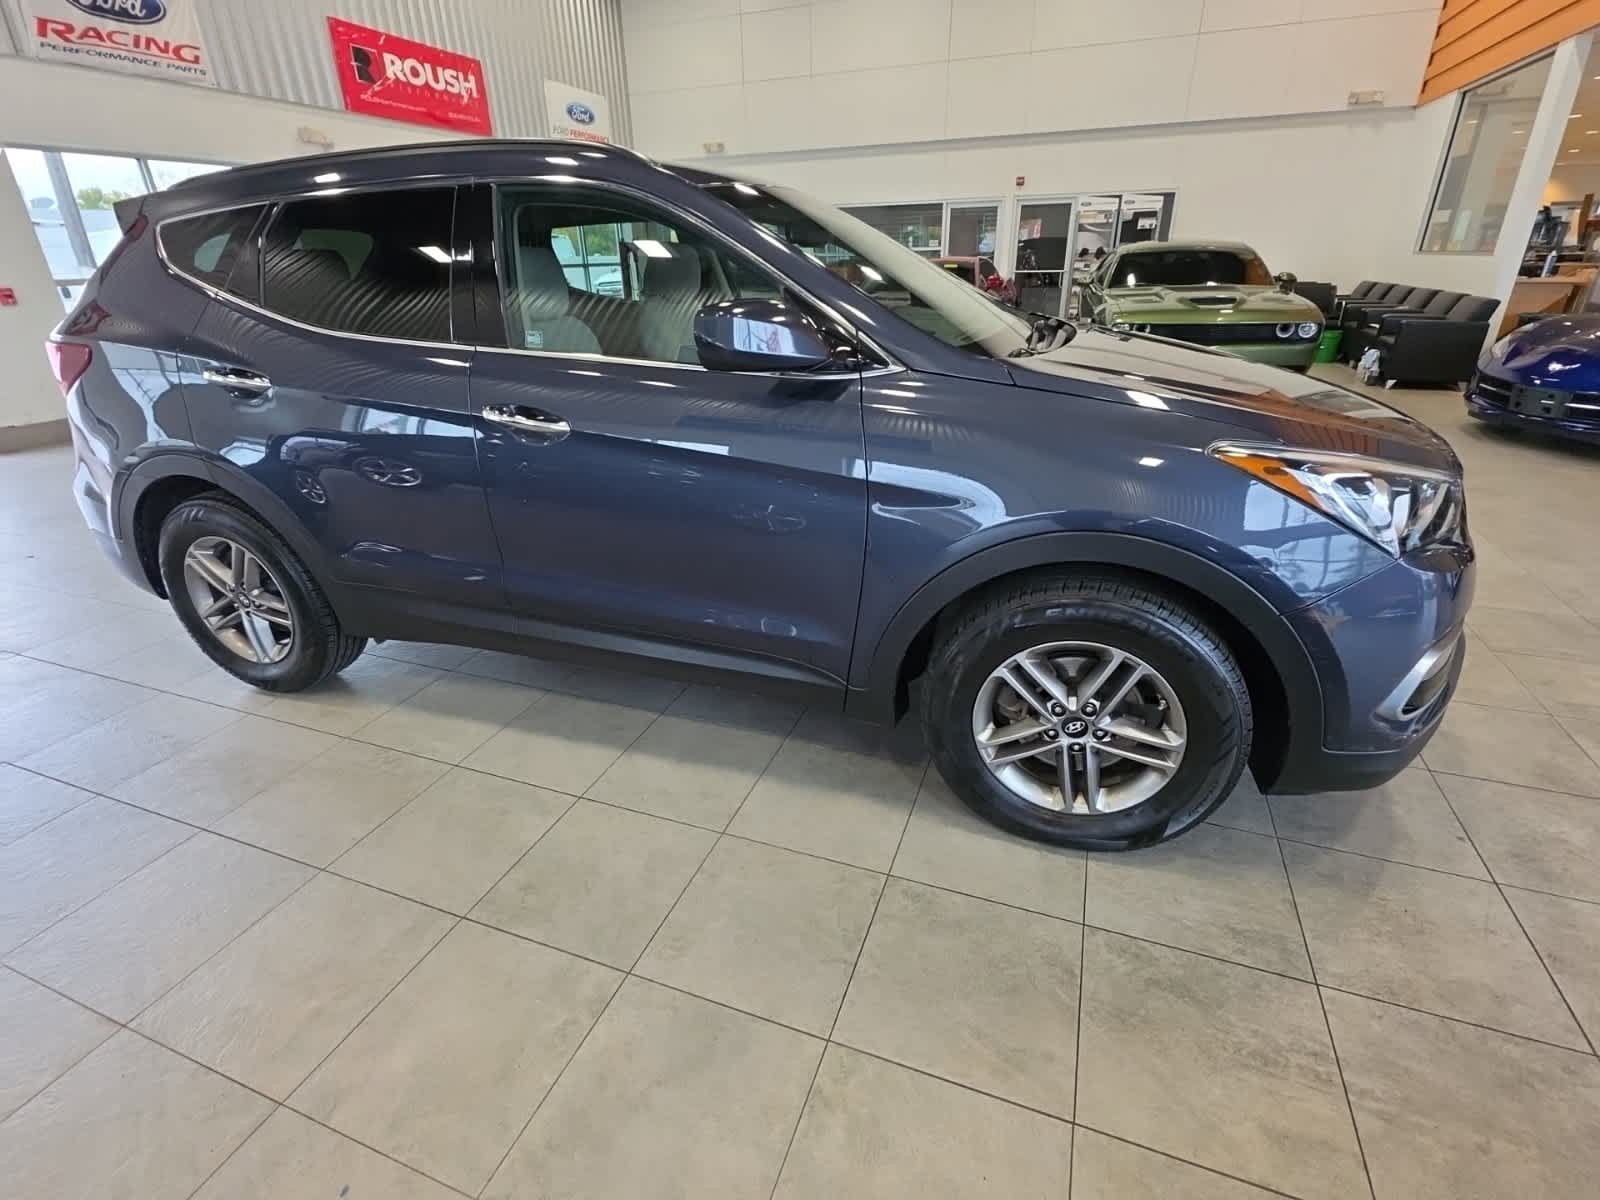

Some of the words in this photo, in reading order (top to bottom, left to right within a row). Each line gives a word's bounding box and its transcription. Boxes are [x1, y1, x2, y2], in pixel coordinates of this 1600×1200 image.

[36, 17, 201, 64] RACING
[39, 41, 161, 67] PERFORMANCE
[166, 62, 207, 76] PARTS
[382, 52, 479, 99] ROUSH
